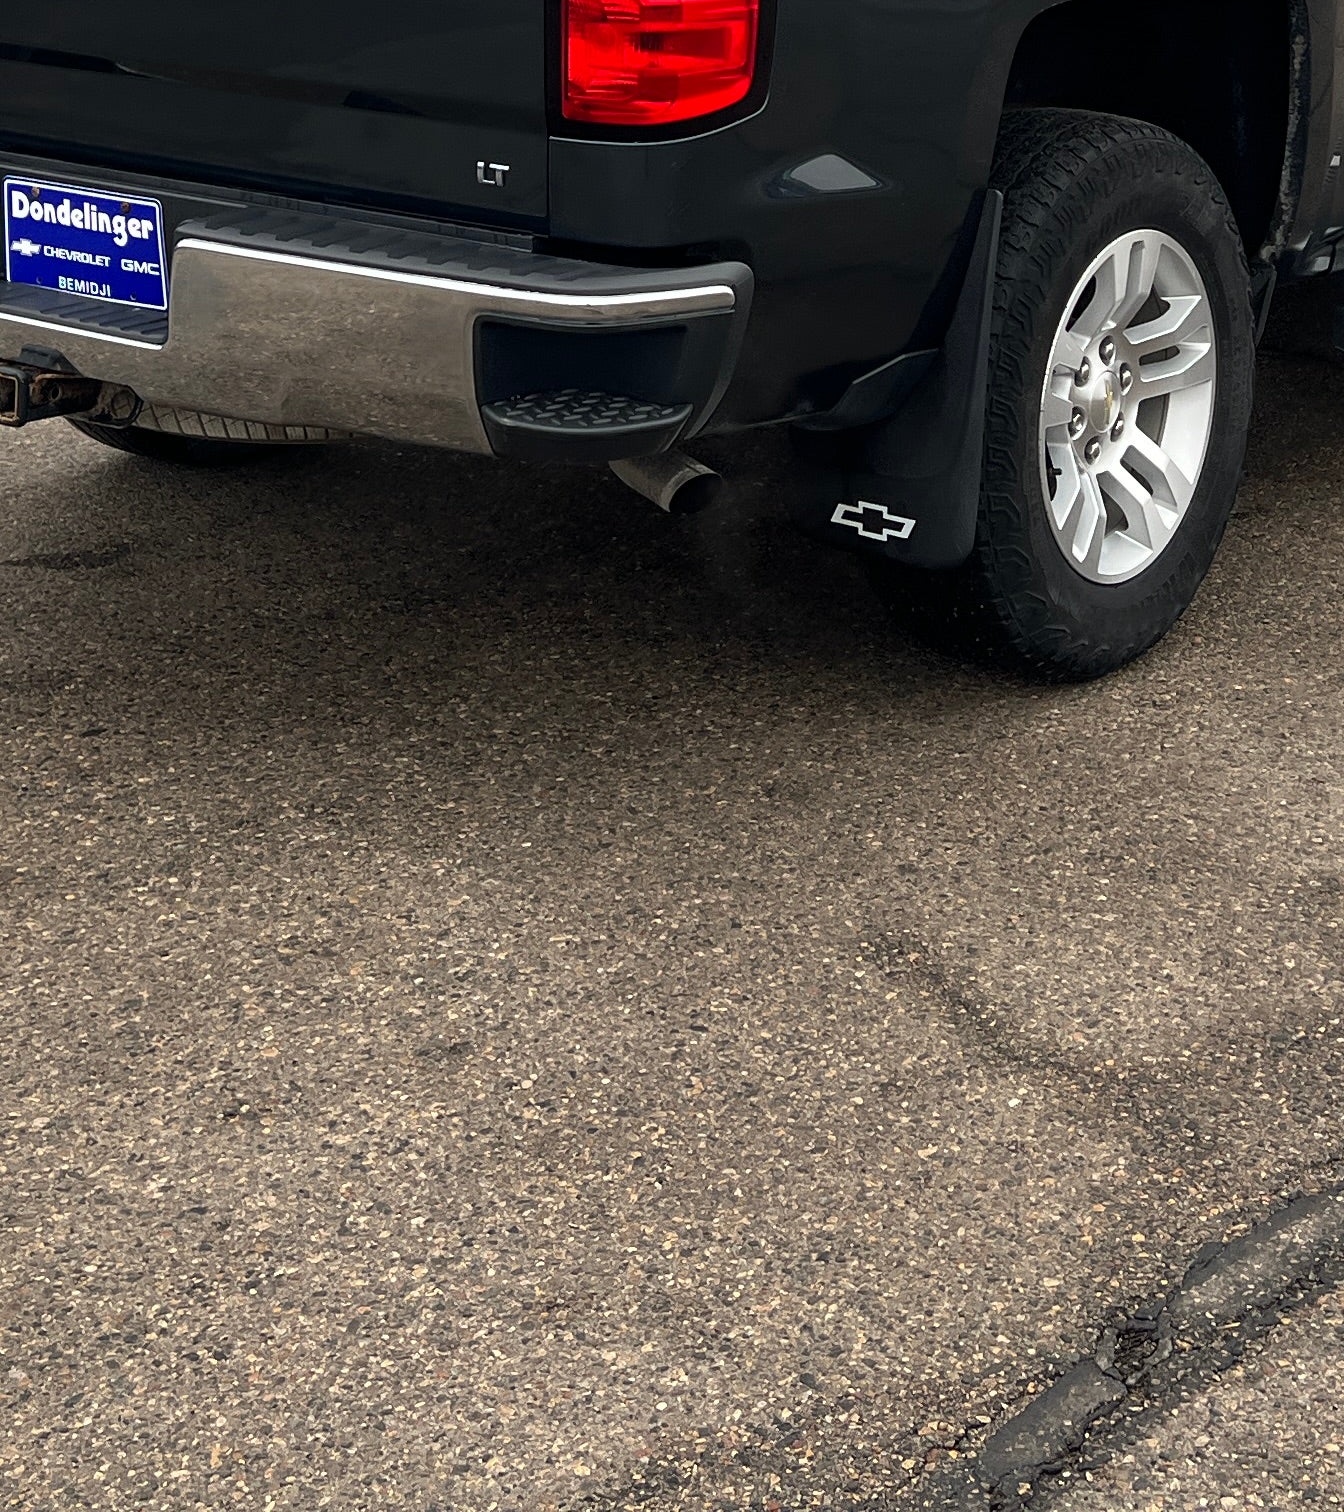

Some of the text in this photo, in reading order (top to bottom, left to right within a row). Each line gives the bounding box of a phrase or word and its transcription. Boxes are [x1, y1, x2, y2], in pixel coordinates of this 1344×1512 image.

[477, 161, 510, 187] LT
[11, 190, 154, 247] Dondelinger
[43, 245, 160, 276] CHEVROLET GMC
[58, 276, 111, 297] BEMIDJI
